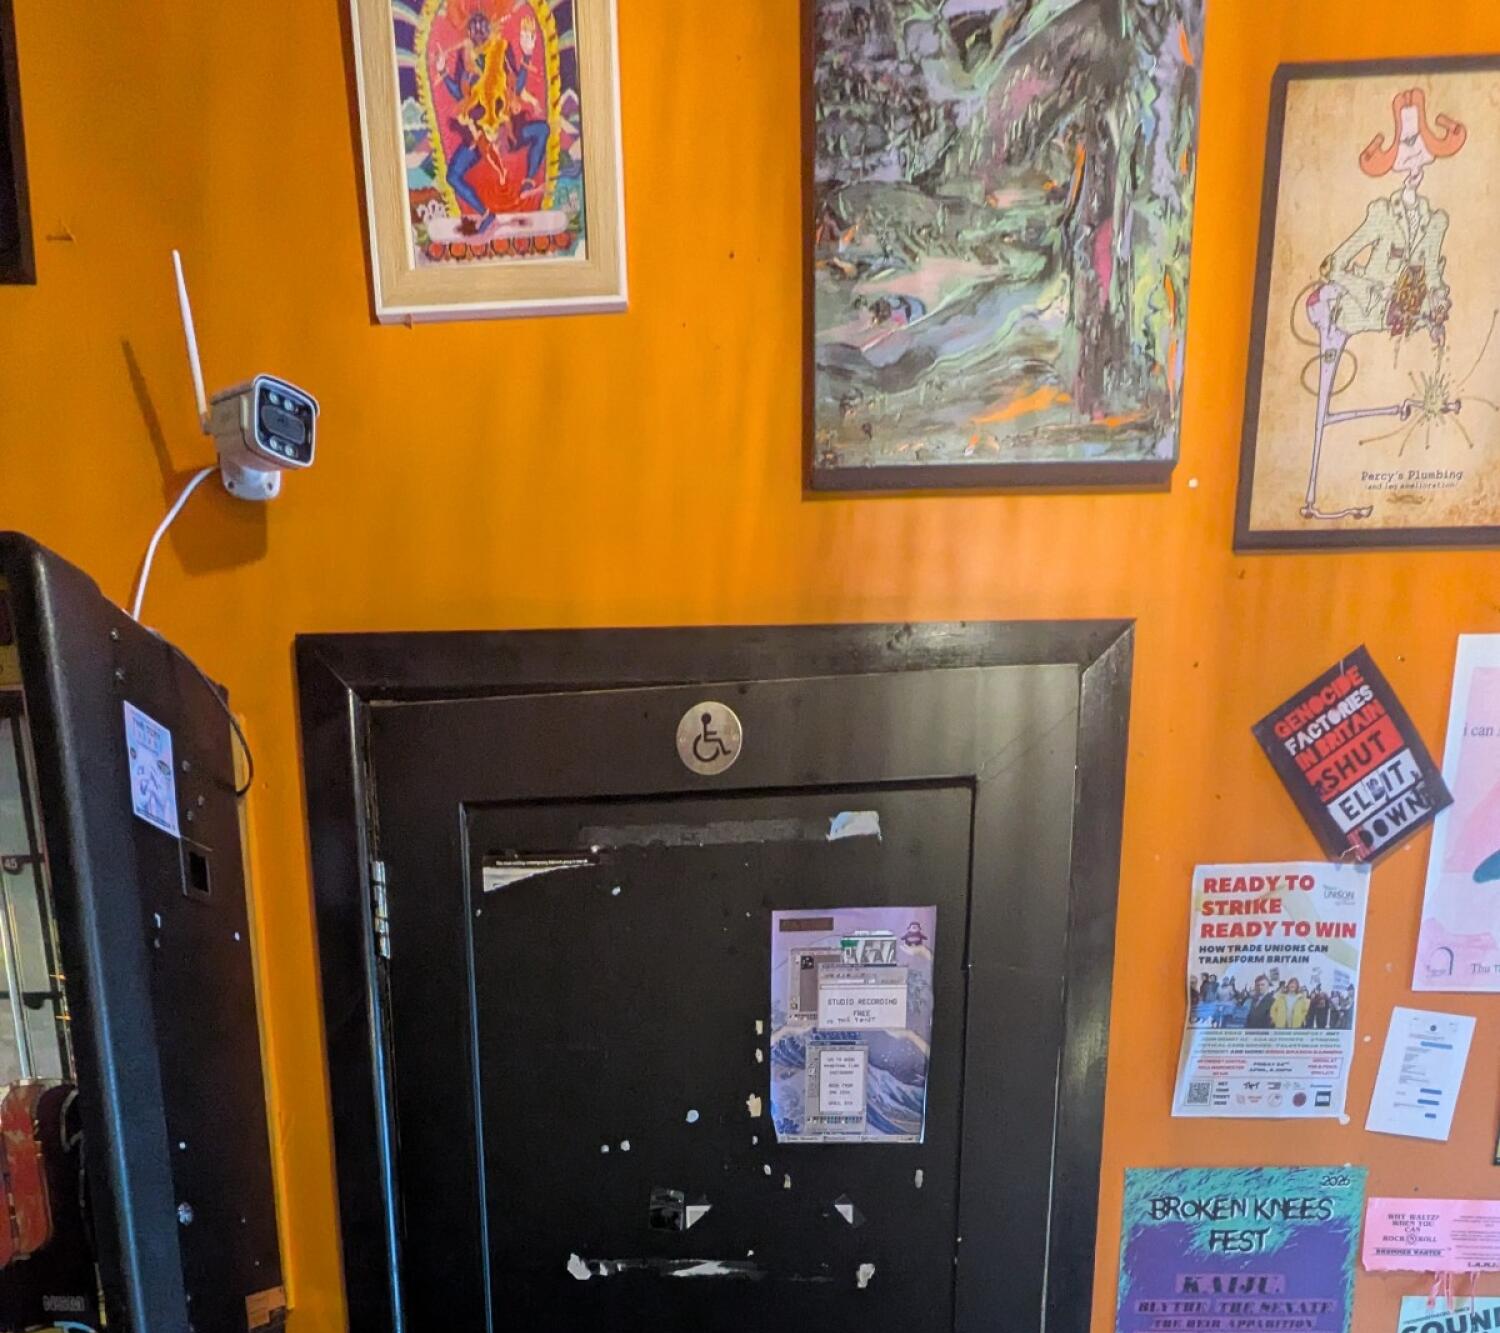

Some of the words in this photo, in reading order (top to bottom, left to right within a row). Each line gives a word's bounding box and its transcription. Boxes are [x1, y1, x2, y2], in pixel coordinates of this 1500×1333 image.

[1408, 470, 1463, 480] Plumbing
[1274, 665, 1363, 739] GENOCIDE
[1285, 684, 1374, 755] FACTORIES
[1294, 746, 1317, 770] IN
[1313, 699, 1386, 761] BRITAIN
[1471, 726, 1494, 737] can
[1321, 731, 1384, 789] SHUT
[1359, 792, 1431, 848] DOWN
[1203, 876, 1281, 893] READY
[1285, 875, 1315, 891] TO
[1201, 898, 1282, 916] STRIKE
[1201, 922, 1278, 939] READY
[1281, 921, 1311, 938] TO
[1315, 922, 1357, 939] WIN
[1199, 945, 1225, 954] HOW
[1228, 944, 1262, 953] TRADE
[1264, 944, 1306, 953] UNIONS
[1308, 944, 1329, 953] CAN
[1199, 955, 1265, 964] TRANSFORM
[1266, 955, 1310, 963] BRITAIN
[1150, 1196, 1247, 1221] BROKEN
[1254, 1198, 1334, 1221] KNEES
[1209, 1228, 1271, 1252] FEST
